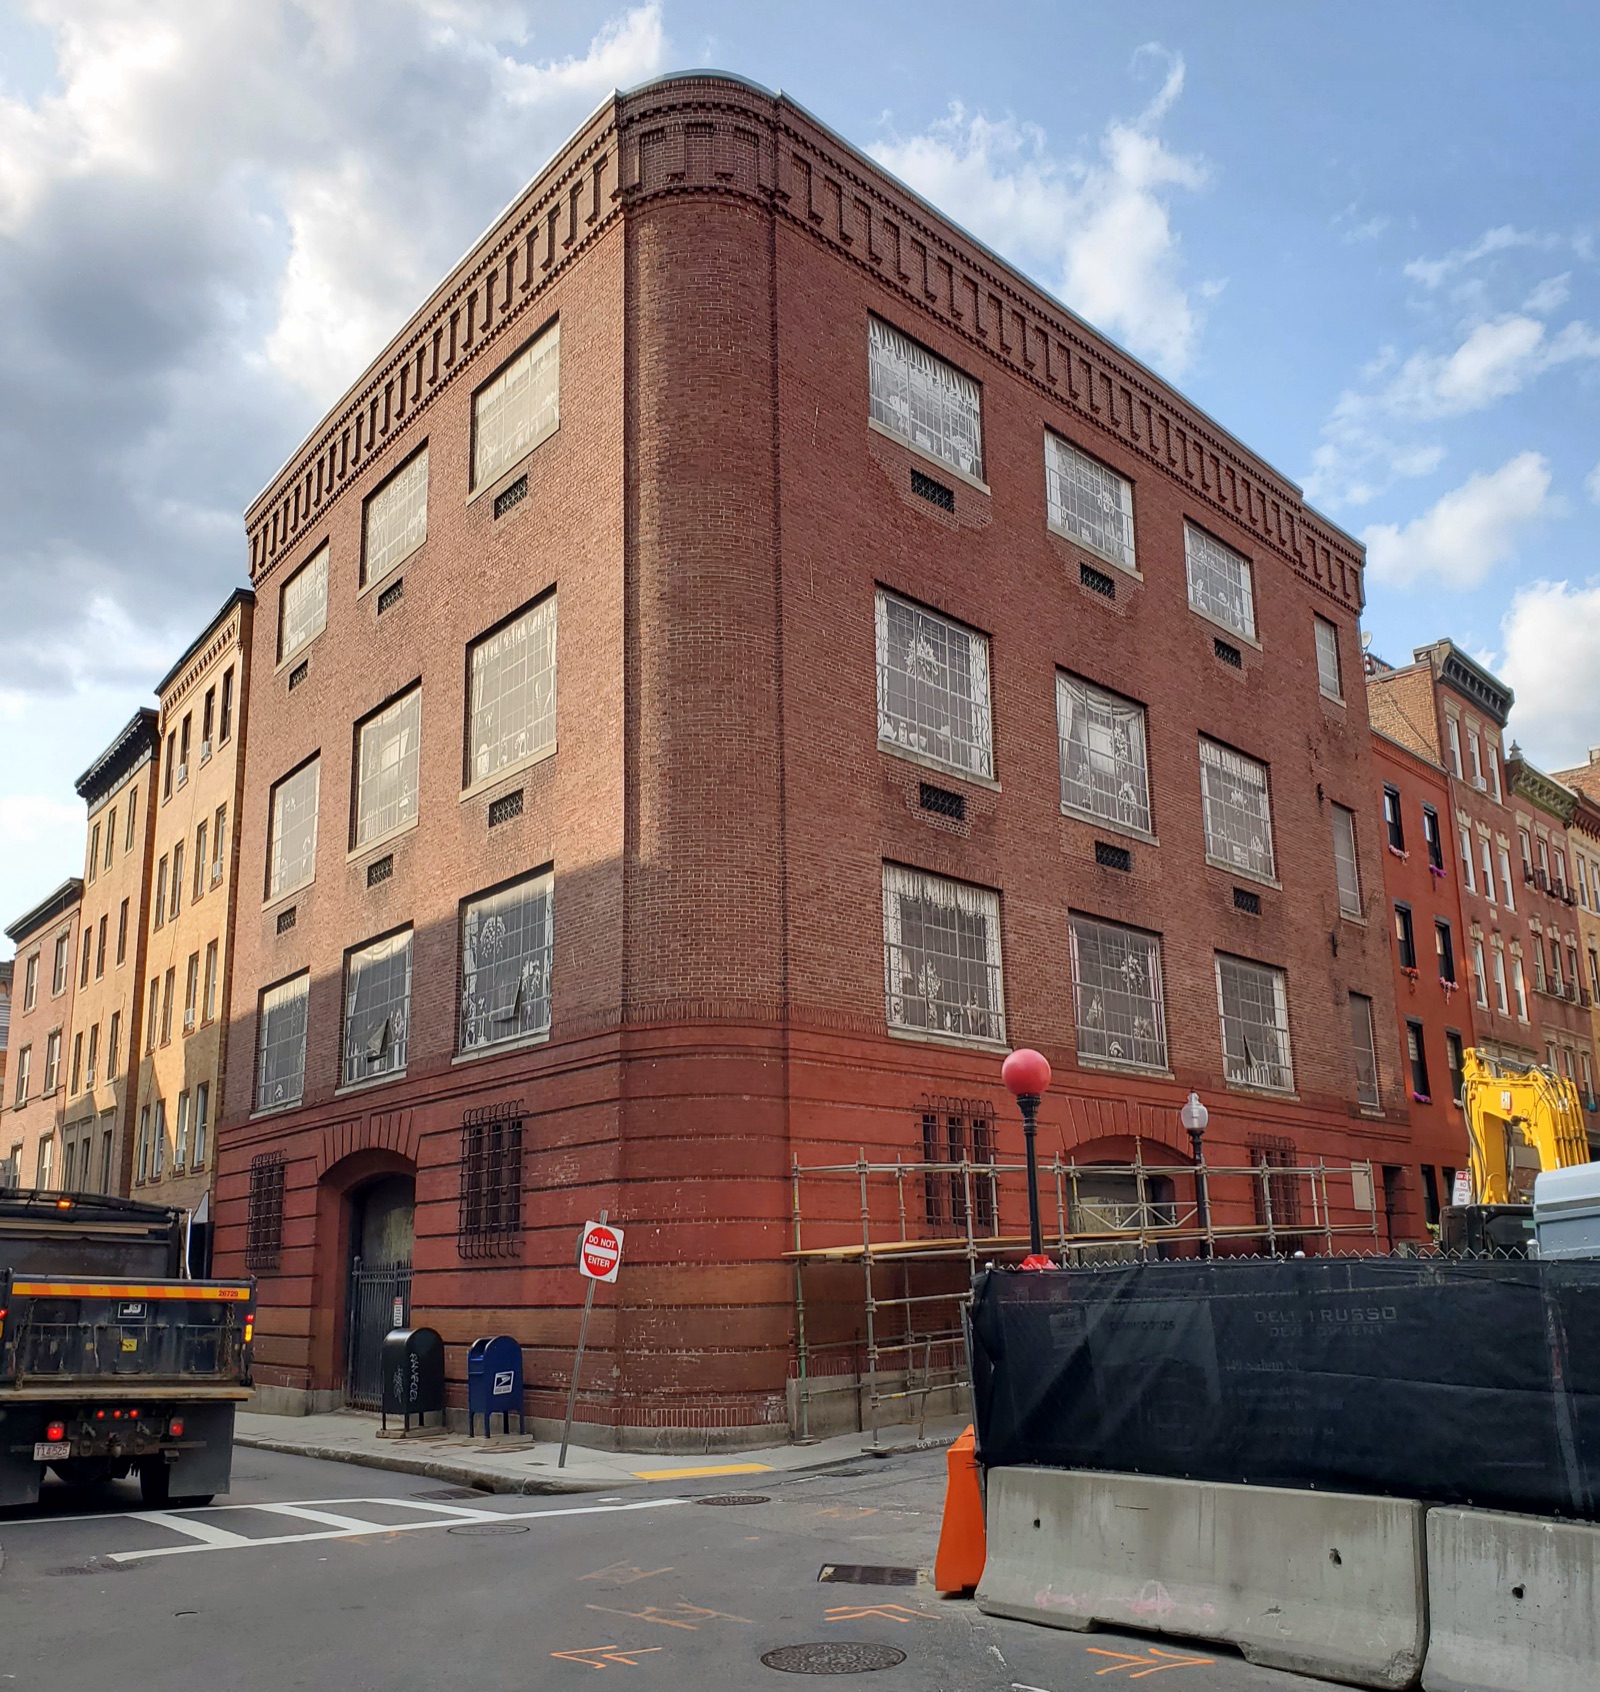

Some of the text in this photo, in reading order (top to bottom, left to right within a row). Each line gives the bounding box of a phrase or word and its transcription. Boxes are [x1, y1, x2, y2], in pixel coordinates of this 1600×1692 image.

[588, 1234, 616, 1249] DO NOT
[587, 1255, 611, 1268] ENTER
